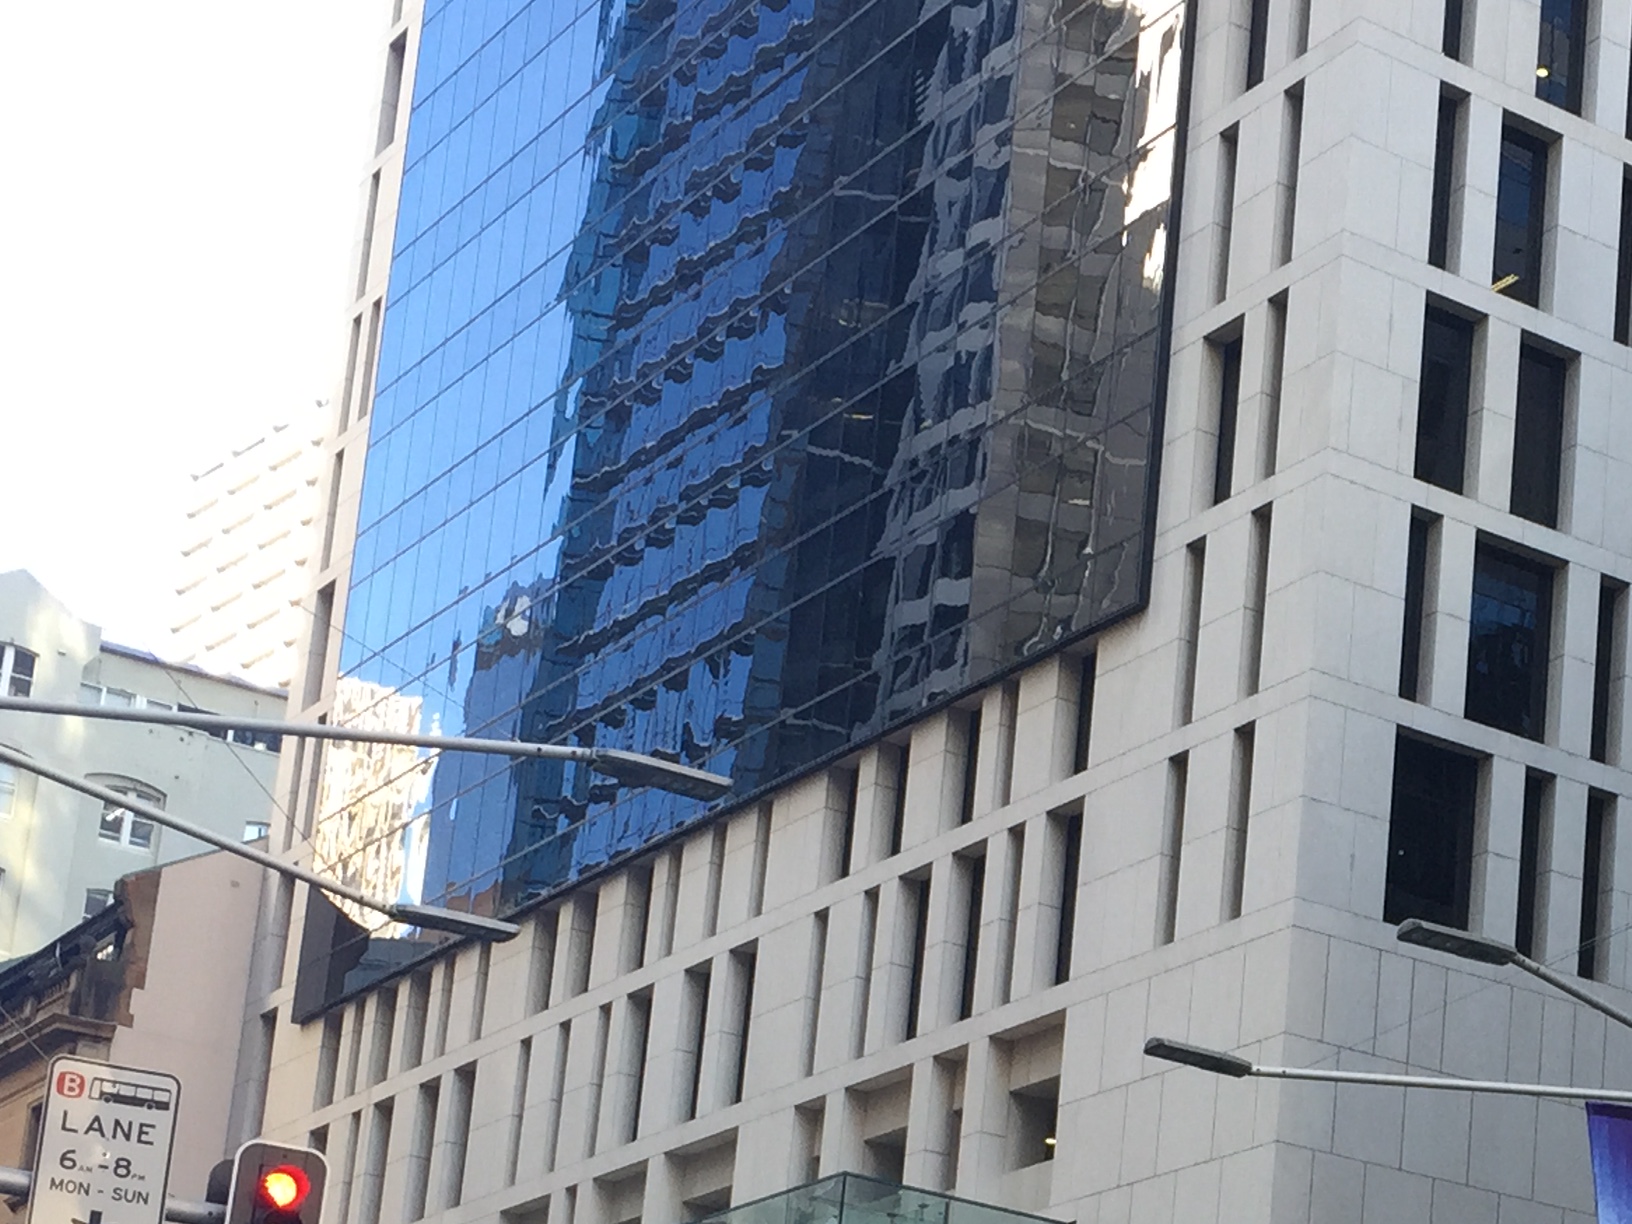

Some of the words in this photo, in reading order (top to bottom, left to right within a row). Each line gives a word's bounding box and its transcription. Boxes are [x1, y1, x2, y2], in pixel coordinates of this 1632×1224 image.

[61, 1109, 156, 1146] LANE
[49, 1177, 91, 1196] MON
[111, 1187, 149, 1205] SUN
